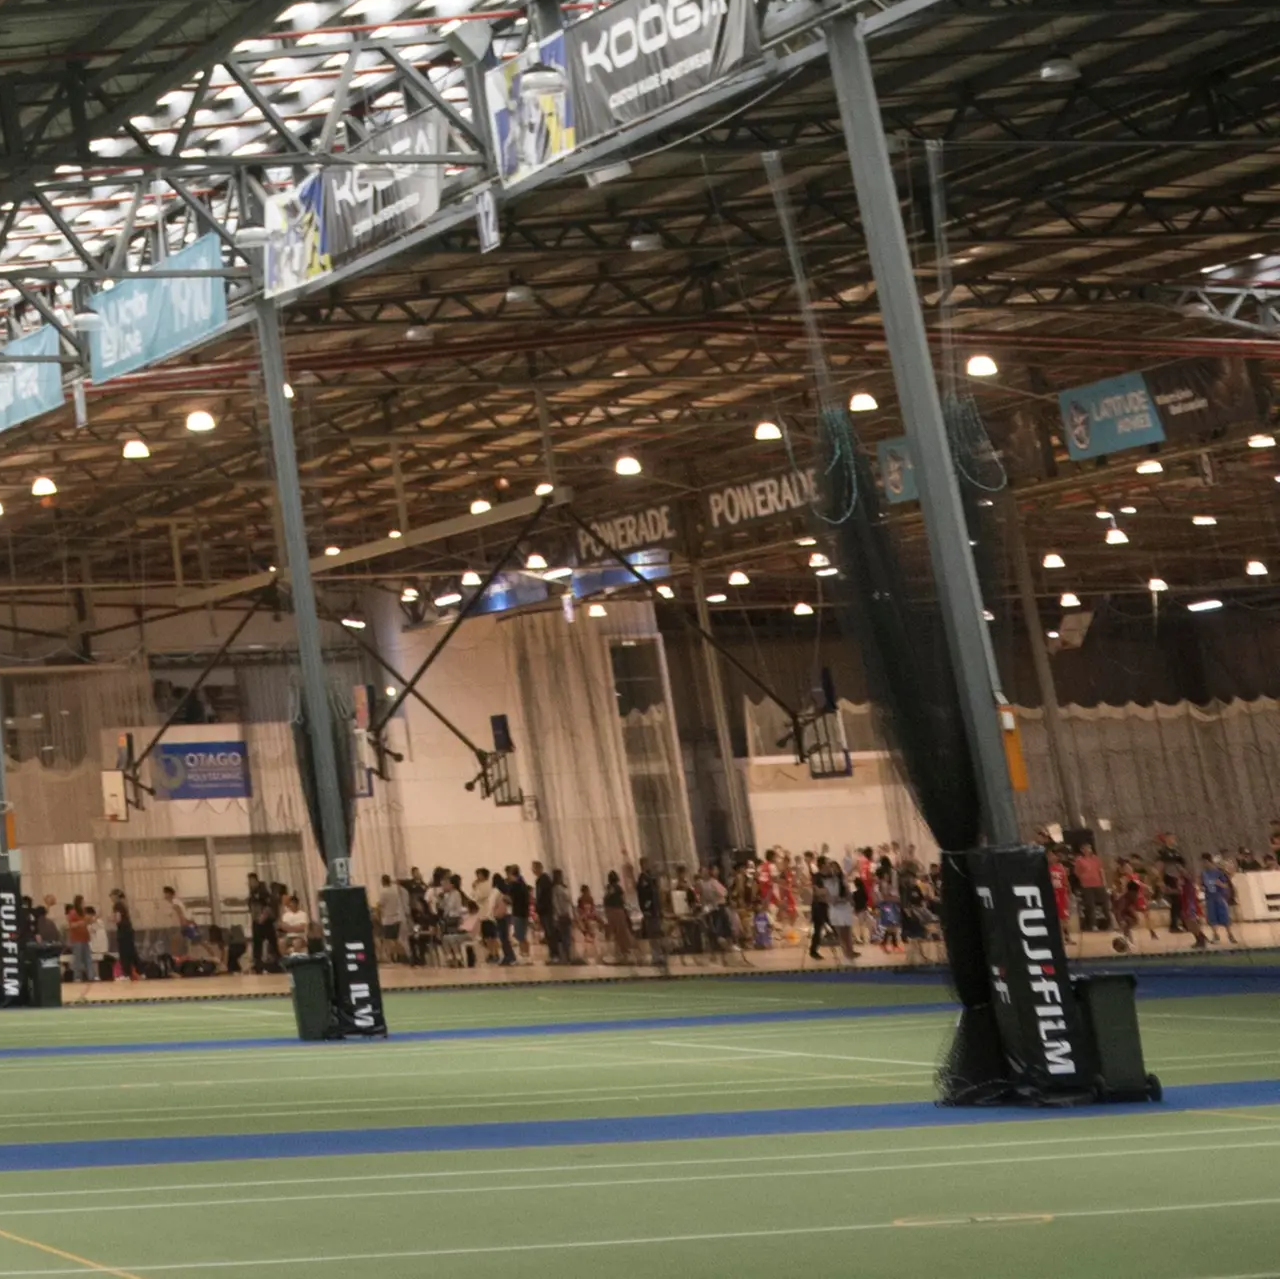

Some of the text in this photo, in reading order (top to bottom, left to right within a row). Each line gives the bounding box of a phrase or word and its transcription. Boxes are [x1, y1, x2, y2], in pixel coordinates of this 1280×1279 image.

[708, 468, 822, 528] POWERADE
[576, 505, 677, 559] POWERADE
[184, 751, 242, 768] OTAGO
[0, 892, 20, 997] FUJIFILM
[1012, 885, 1077, 1076] FUJIFILM
